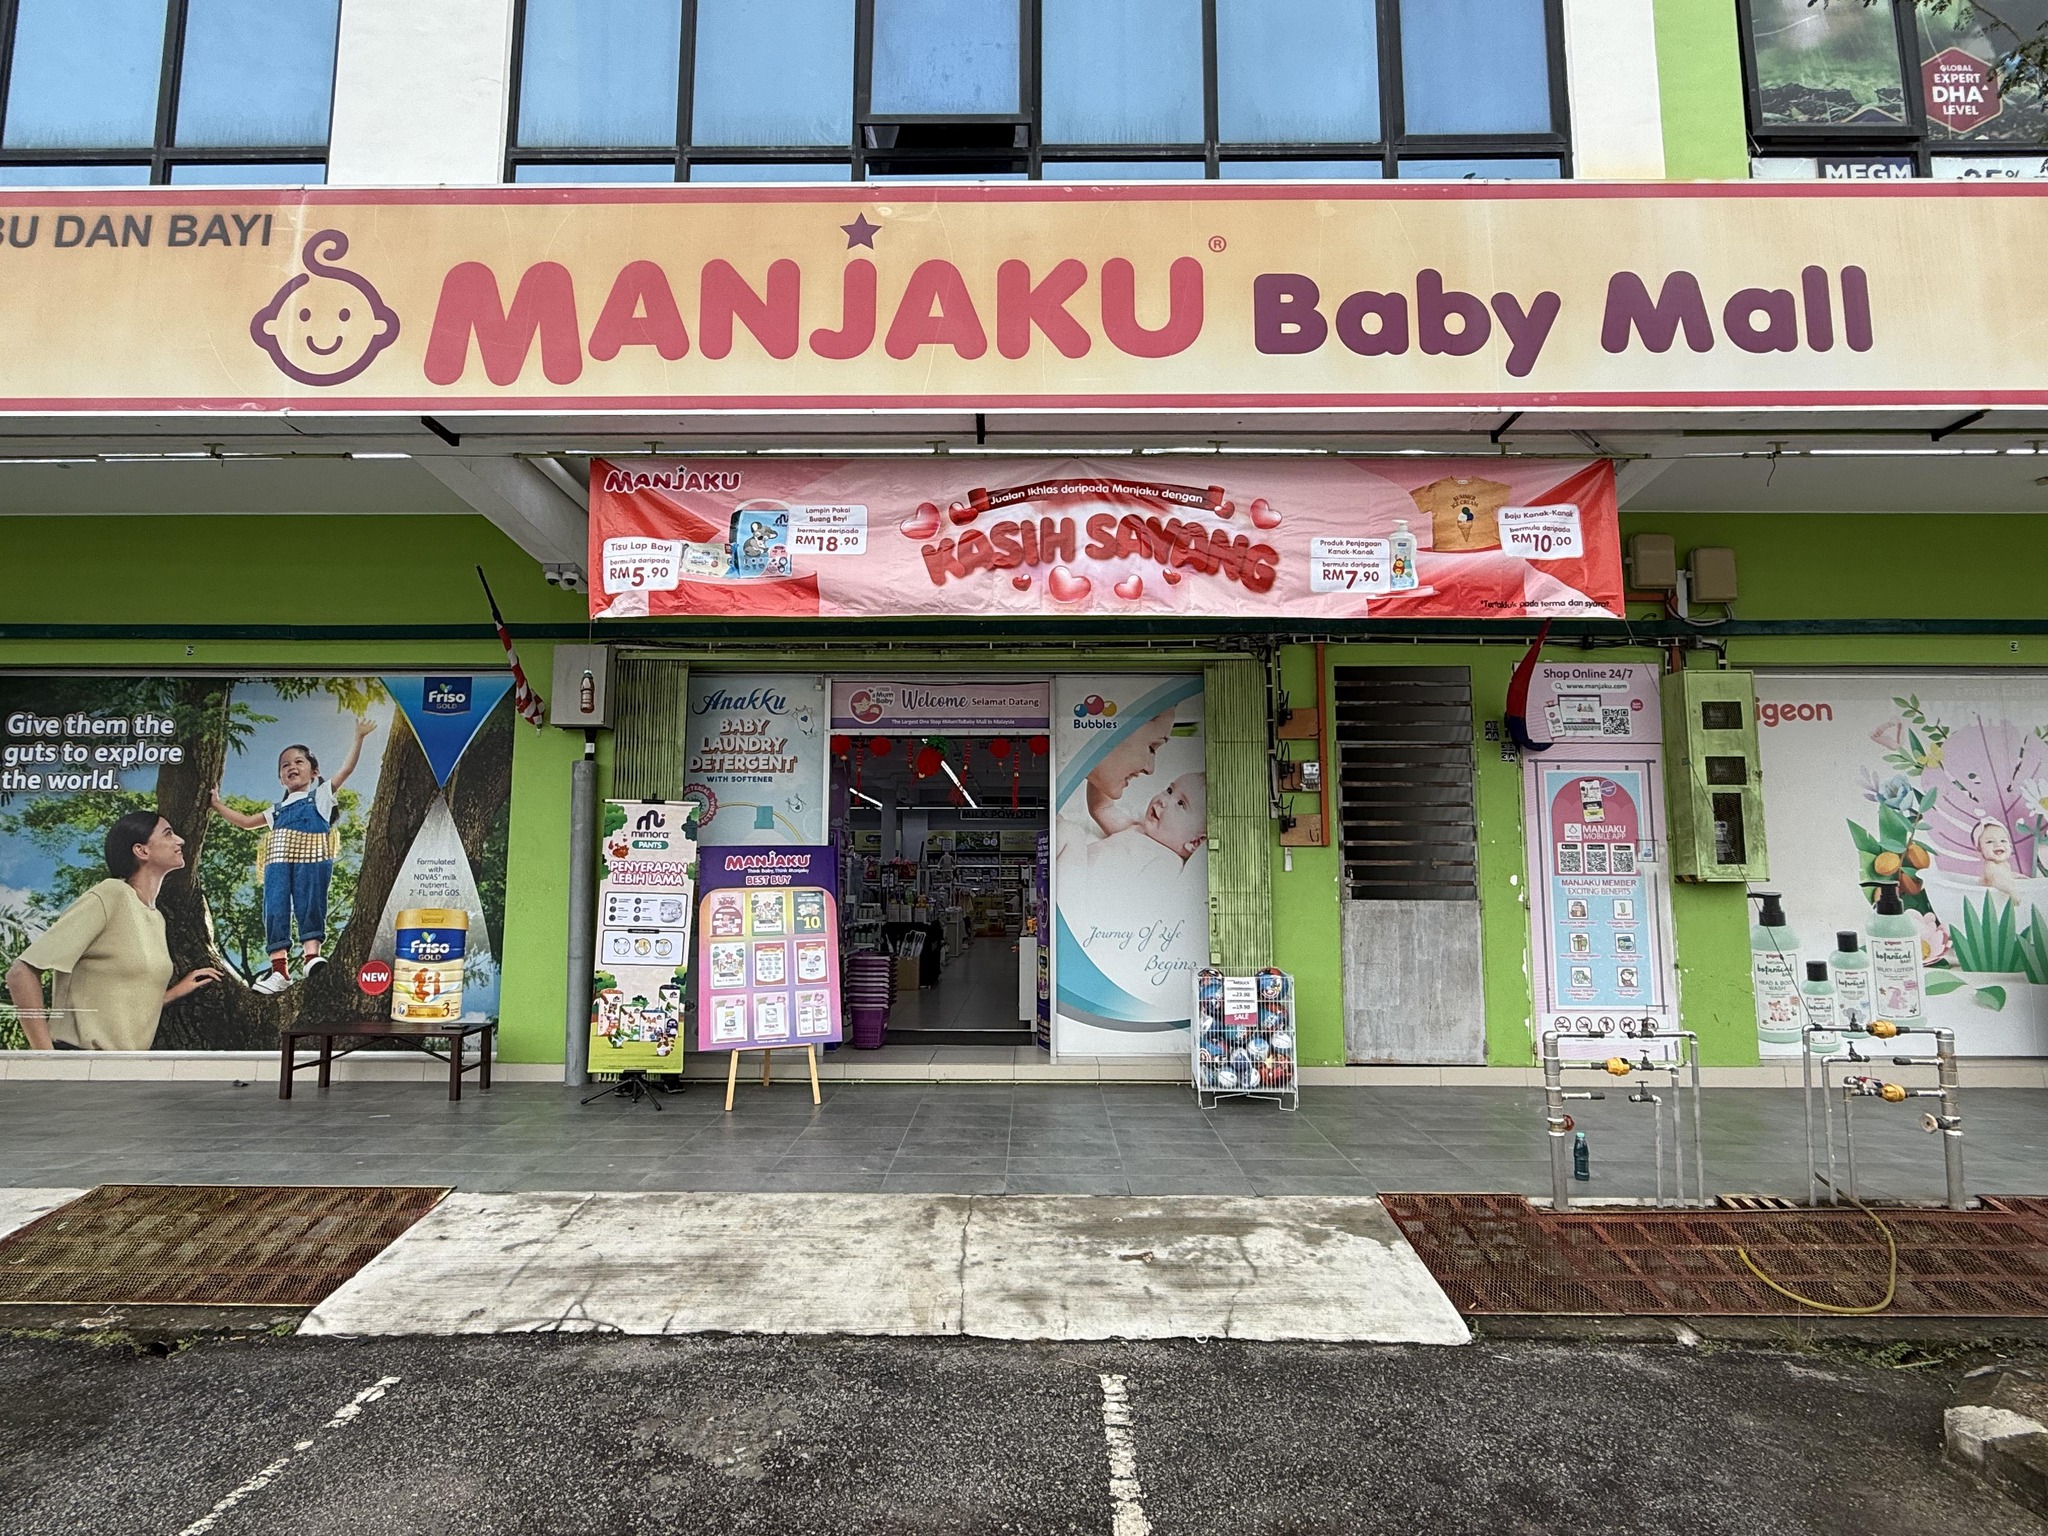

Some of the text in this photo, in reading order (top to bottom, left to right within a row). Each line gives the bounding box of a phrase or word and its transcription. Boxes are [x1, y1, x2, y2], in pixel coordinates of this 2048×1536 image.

[1934, 73, 1980, 84] EXPERT
[1943, 105, 1979, 115] LEVEL
[0, 214, 272, 248] U DAN BAYI
[423, 256, 1204, 386] MANJAKU
[1254, 265, 1873, 378] Baby Mall
[604, 469, 741, 493] MANJAKU
[991, 483, 1203, 506] Jualan Ikhlas daripada Manjaku dengan
[805, 507, 830, 515] Lampin
[1504, 509, 1573, 521] Baju Kanak-Kanak
[809, 515, 848, 523] Buang Bayi
[1509, 525, 1540, 533] bermula
[611, 542, 673, 554] Tisu Lap Bayi
[795, 535, 859, 552] RM18.90
[1320, 539, 1382, 549] Produk Penjagaan
[1511, 533, 1572, 553] RM10.00
[921, 513, 1280, 594] KASIH SAYANG
[1328, 548, 1375, 556] Kanak-Kanak
[638, 557, 670, 566] daripada
[1322, 561, 1380, 569] bermula daripada
[609, 566, 669, 587] RM5.90
[1322, 570, 1380, 589] RM7.90
[1543, 668, 1633, 681] Shop Online 24/7
[1566, 684, 1627, 692] www.manjaku.com
[428, 688, 466, 703] Friso
[692, 688, 790, 715] Anakku
[902, 689, 968, 710] Welcome
[972, 698, 1039, 707] Selamat Datang
[7, 714, 175, 735] Give them the
[720, 719, 770, 735] BABY
[1073, 719, 1118, 730] Bubbles
[701, 737, 788, 754] LAUNDRY
[4, 742, 183, 767] guts to explore
[690, 755, 798, 773] DETERGENT
[1, 769, 119, 790] the world.
[963, 809, 1036, 818] MILK POWDER
[631, 830, 670, 838] mimora
[1583, 825, 1626, 833] MANJAKU
[610, 861, 688, 873] PENYERAPAN
[725, 854, 811, 870] MANJAKU
[612, 873, 683, 885] LEBIH LAMA
[746, 875, 792, 885] BEST BUY
[803, 916, 820, 928] 10
[1083, 926, 1133, 949] Journey
[1159, 920, 1182, 951] Life
[410, 938, 450, 953] Friso
[1876, 951, 1911, 962] botanical
[1757, 964, 1793, 975] botanical
[362, 972, 388, 982] NEW
[441, 1002, 450, 1016] 3
